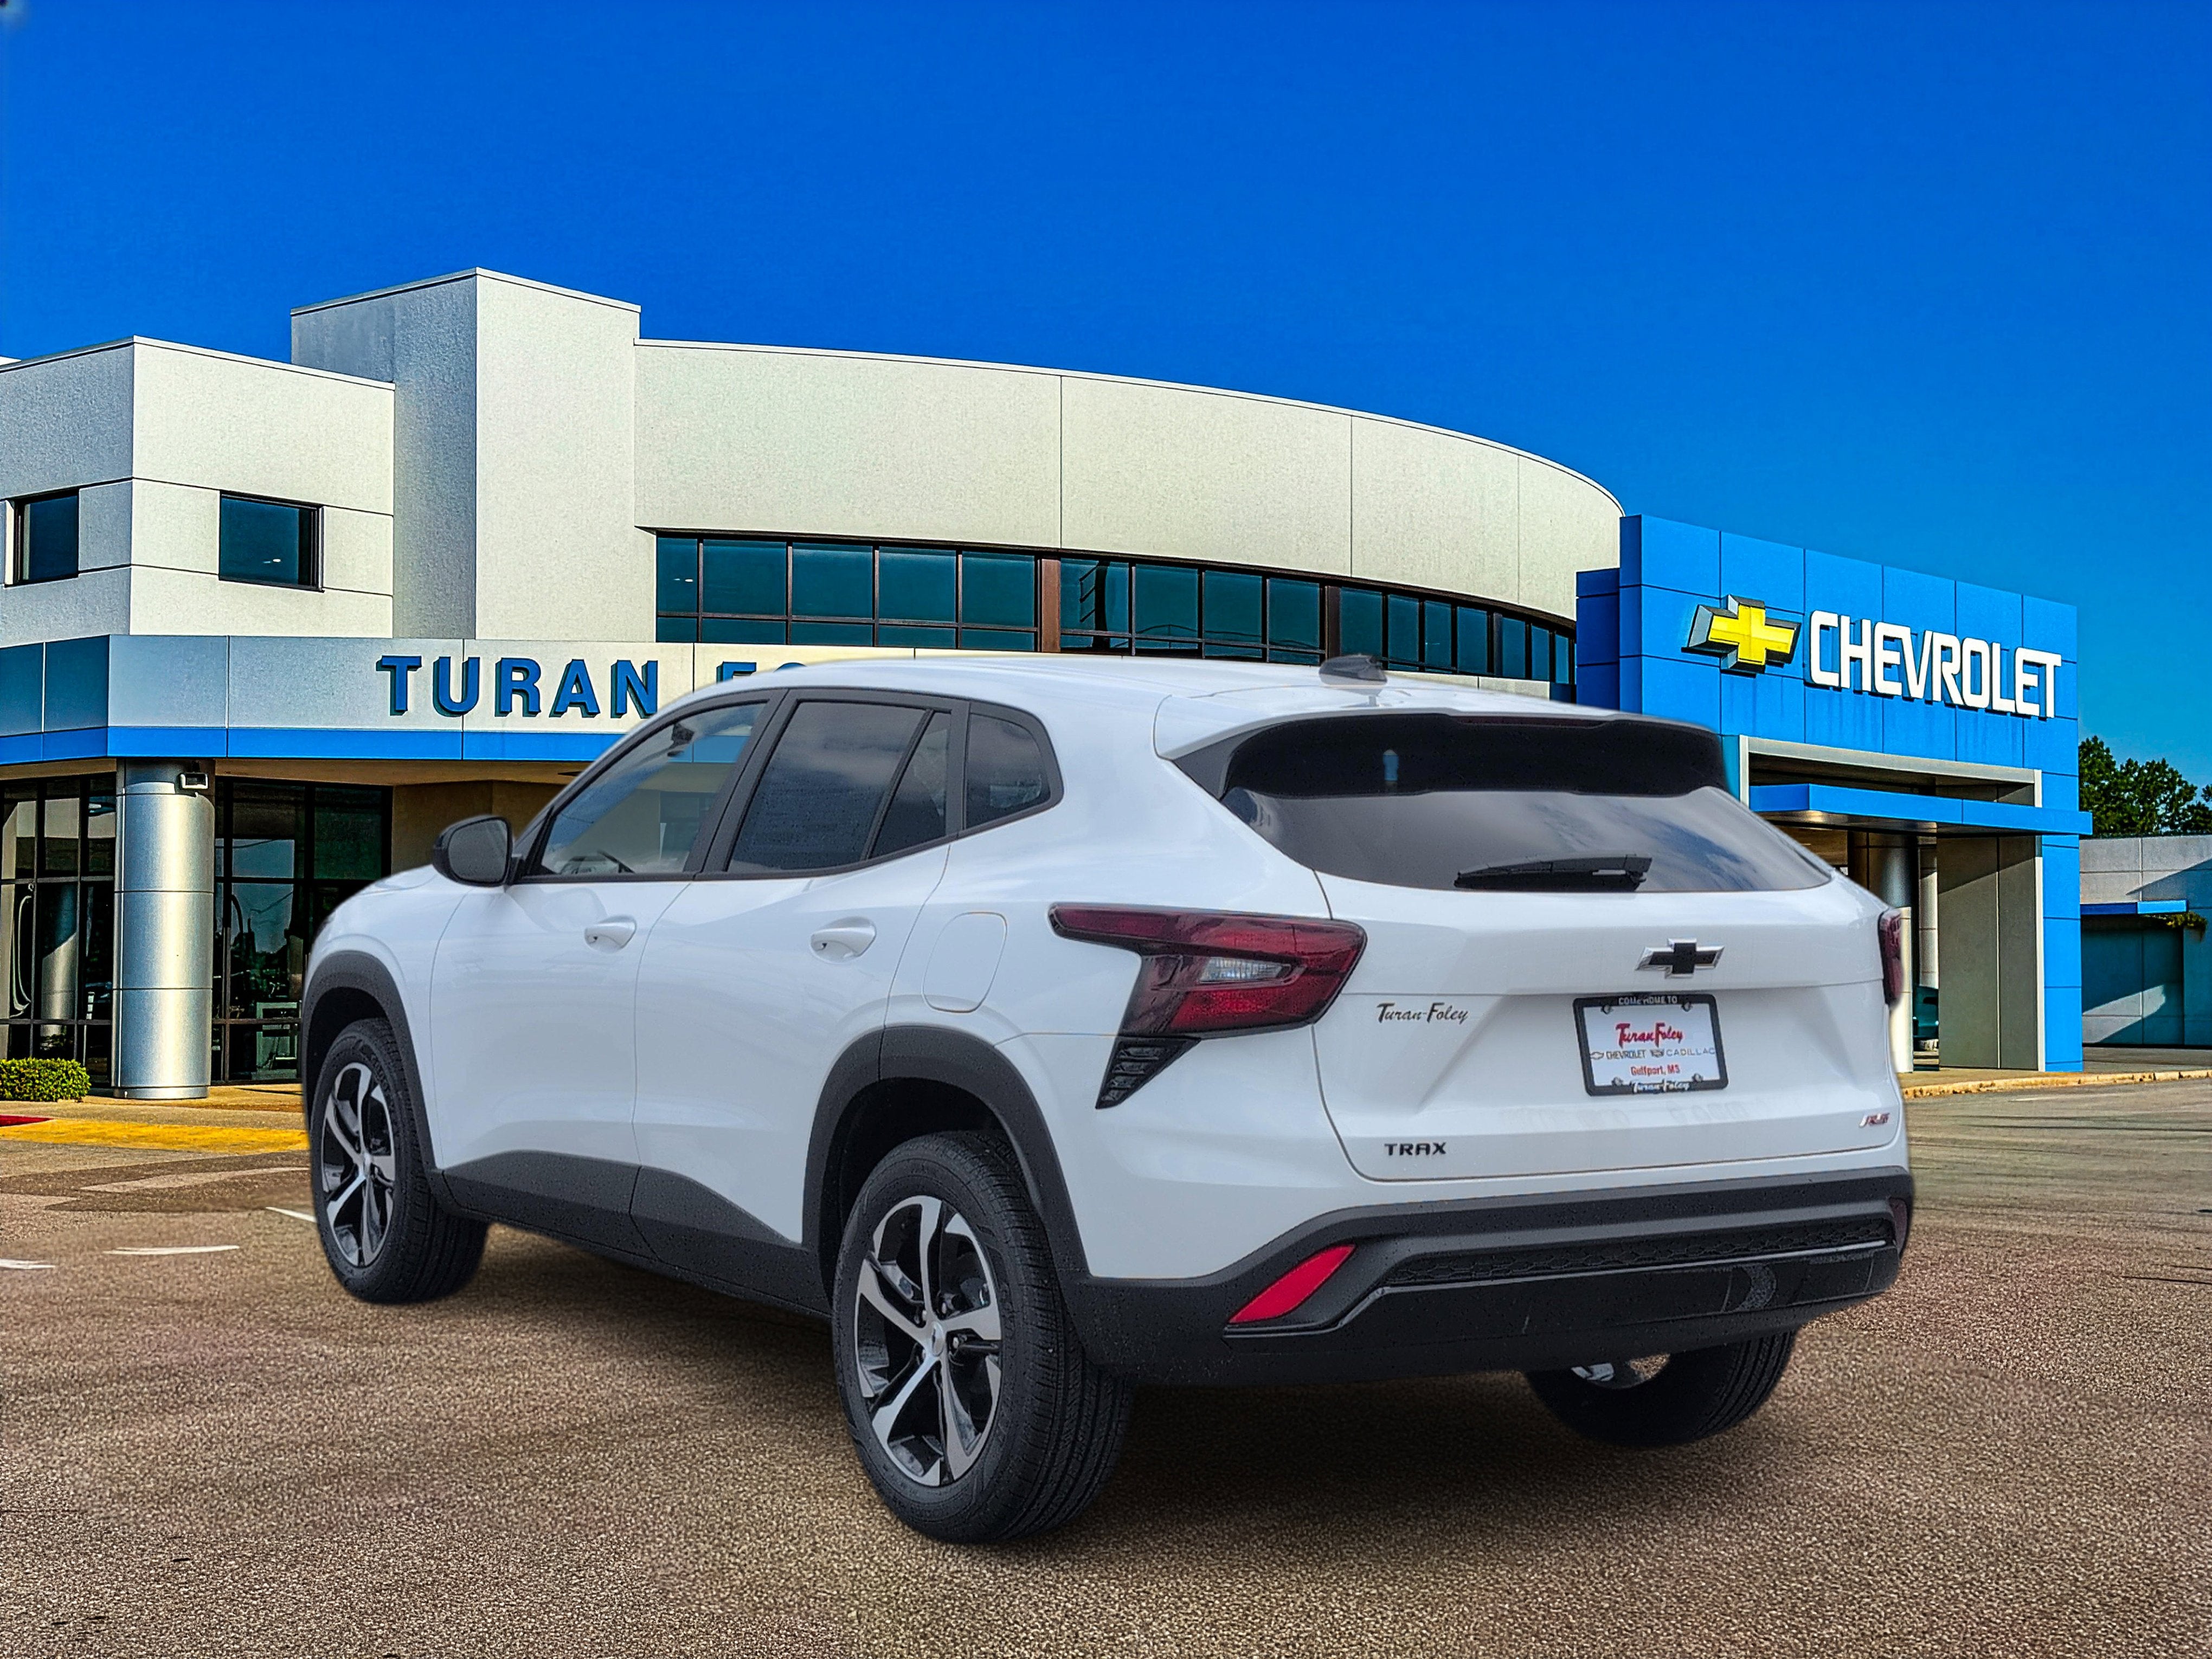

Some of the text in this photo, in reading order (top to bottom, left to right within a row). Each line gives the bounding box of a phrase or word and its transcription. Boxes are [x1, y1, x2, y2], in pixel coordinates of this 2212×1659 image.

[1809, 610, 2062, 719] CHEVROLET
[375, 655, 658, 718] TURAN
[1666, 1047, 1715, 1057] CADILLAC
[1384, 1142, 1446, 1156] TRAX
